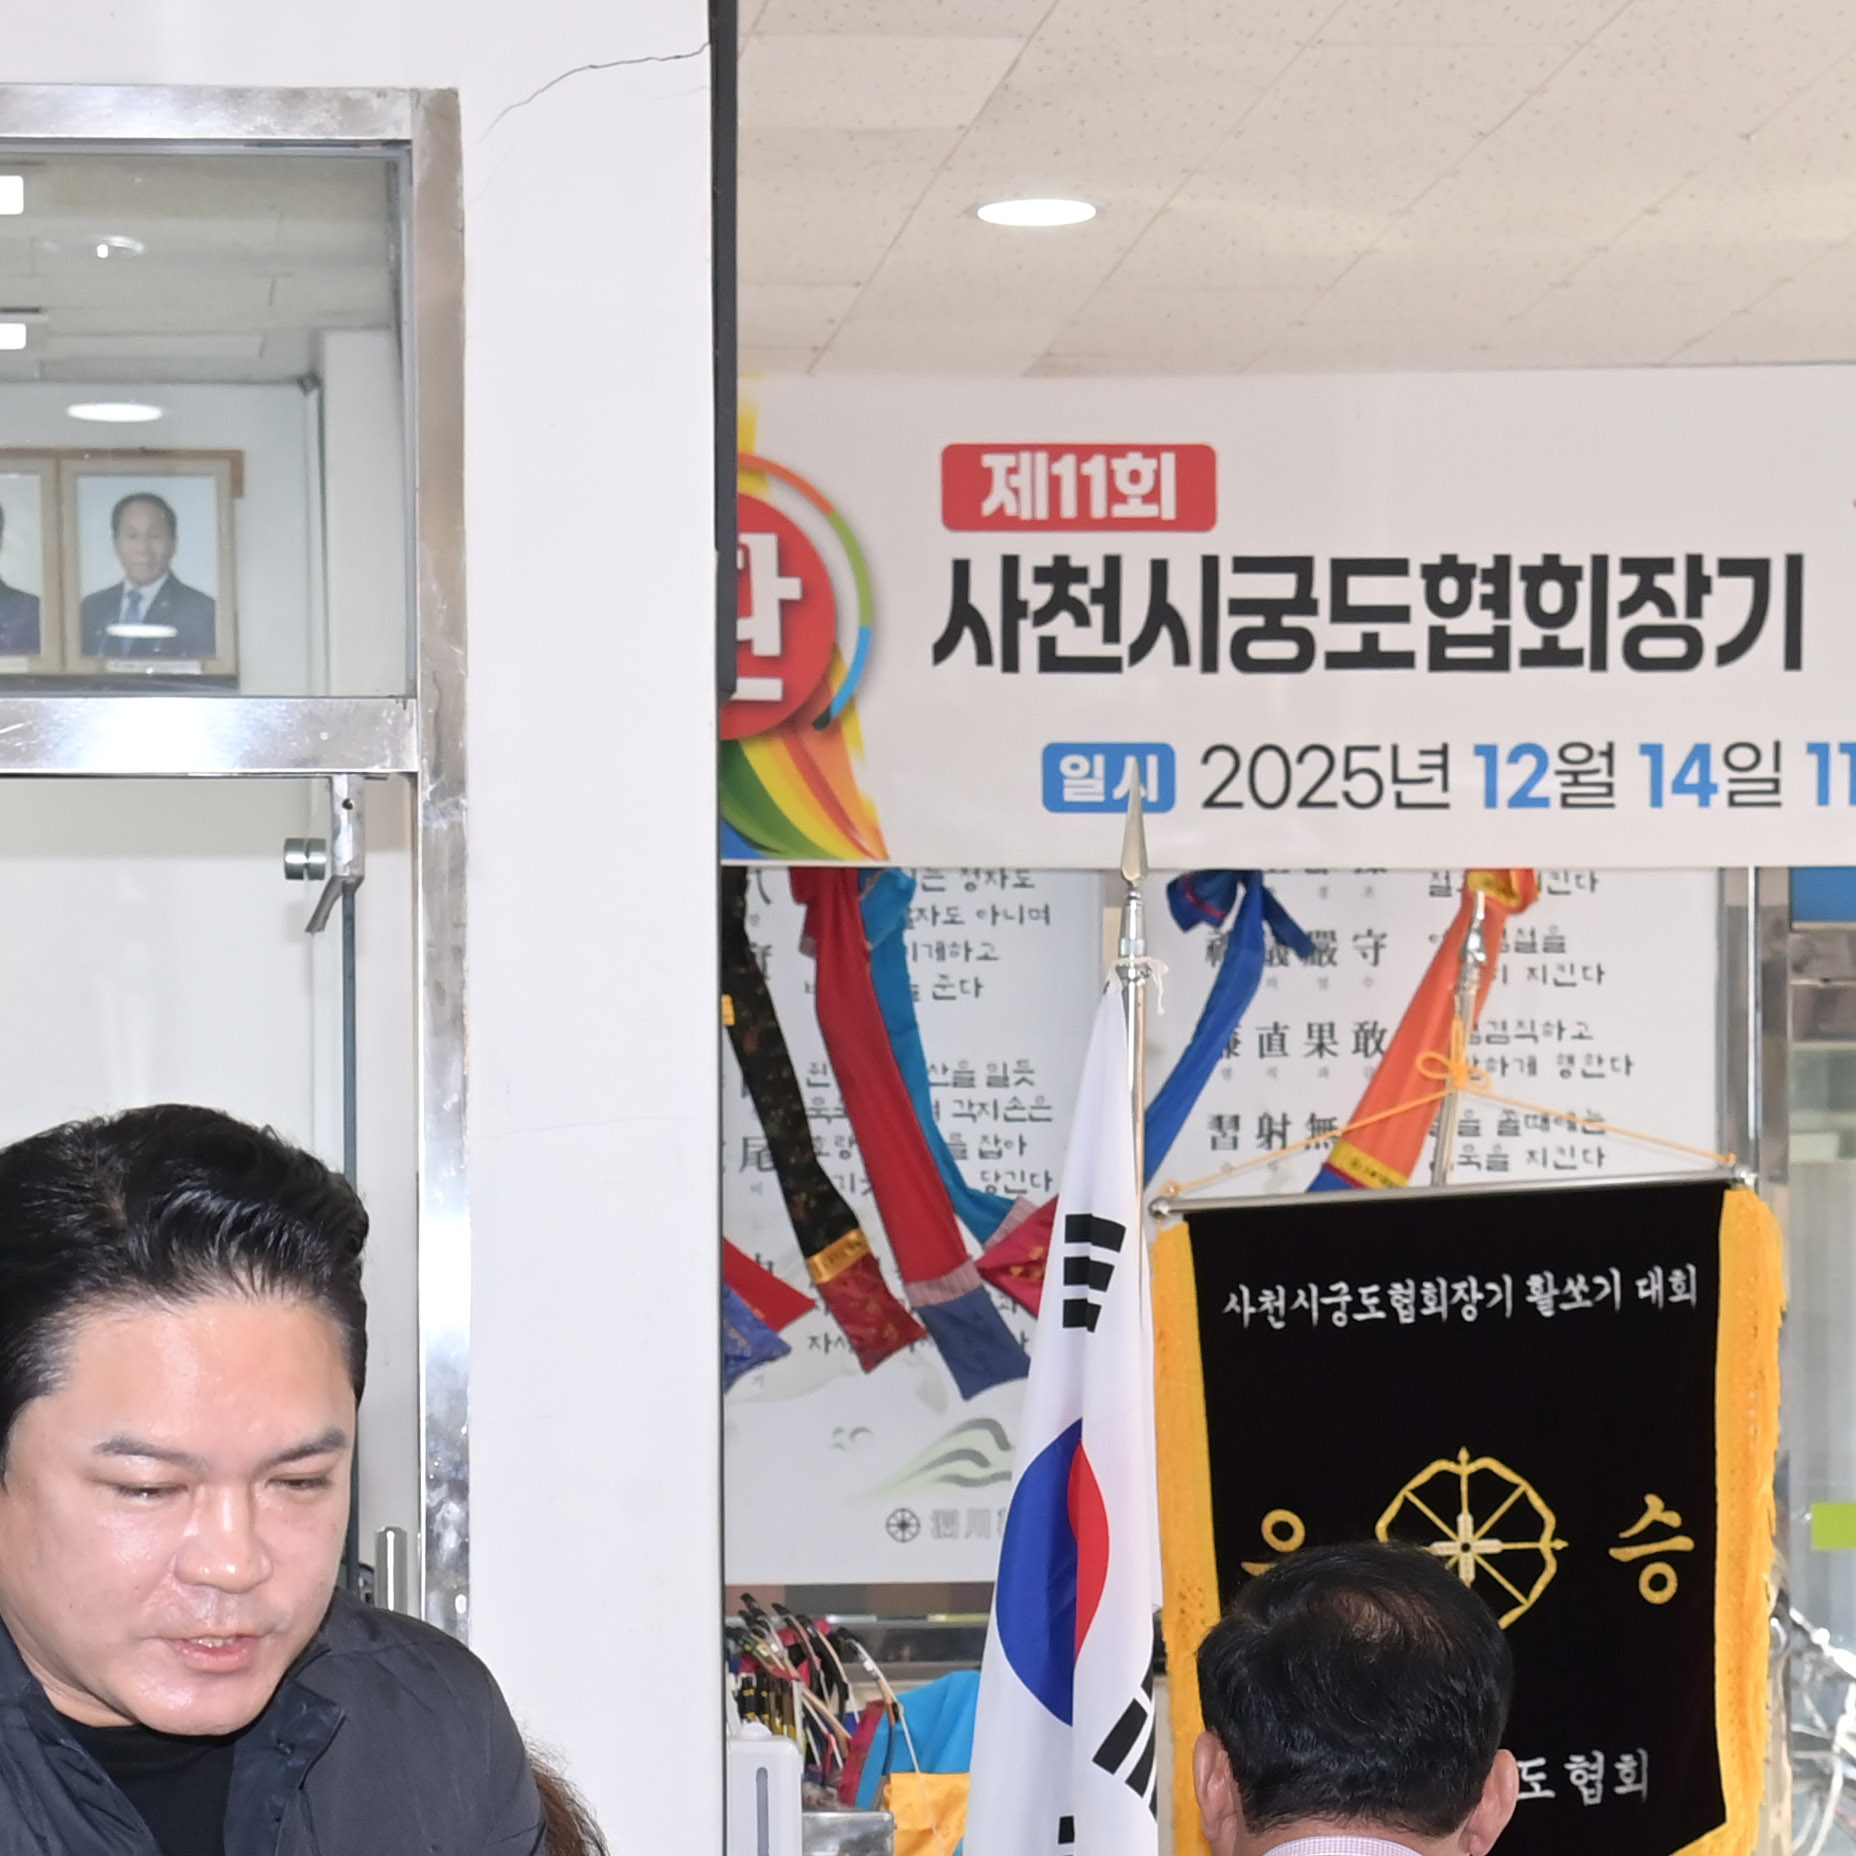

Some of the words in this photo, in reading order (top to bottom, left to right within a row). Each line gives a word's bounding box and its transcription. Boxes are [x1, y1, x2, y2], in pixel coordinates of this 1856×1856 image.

[980, 450, 1179, 522] 제11회
[931, 550, 1806, 675] 사천시궁도협회장기
[1200, 741, 1452, 811] 2025년
[1473, 741, 1618, 810] 12월
[1638, 741, 1783, 810] 14일
[1537, 870, 1598, 895] 킨다
[904, 904, 965, 929] 자도
[976, 904, 1051, 926] 아니며
[911, 941, 999, 962] 게하고
[1500, 923, 1566, 954] 절을
[932, 974, 982, 1001] 준다
[1526, 963, 1605, 987] 지킨다
[1526, 1146, 1605, 1171] 지킨다
[1222, 1273, 1513, 1330] 사천시궁도협회장기
[1525, 1266, 1622, 1319] 활쏘기
[1635, 1262, 1698, 1311] 대회
[1608, 1493, 1695, 1605] 승
